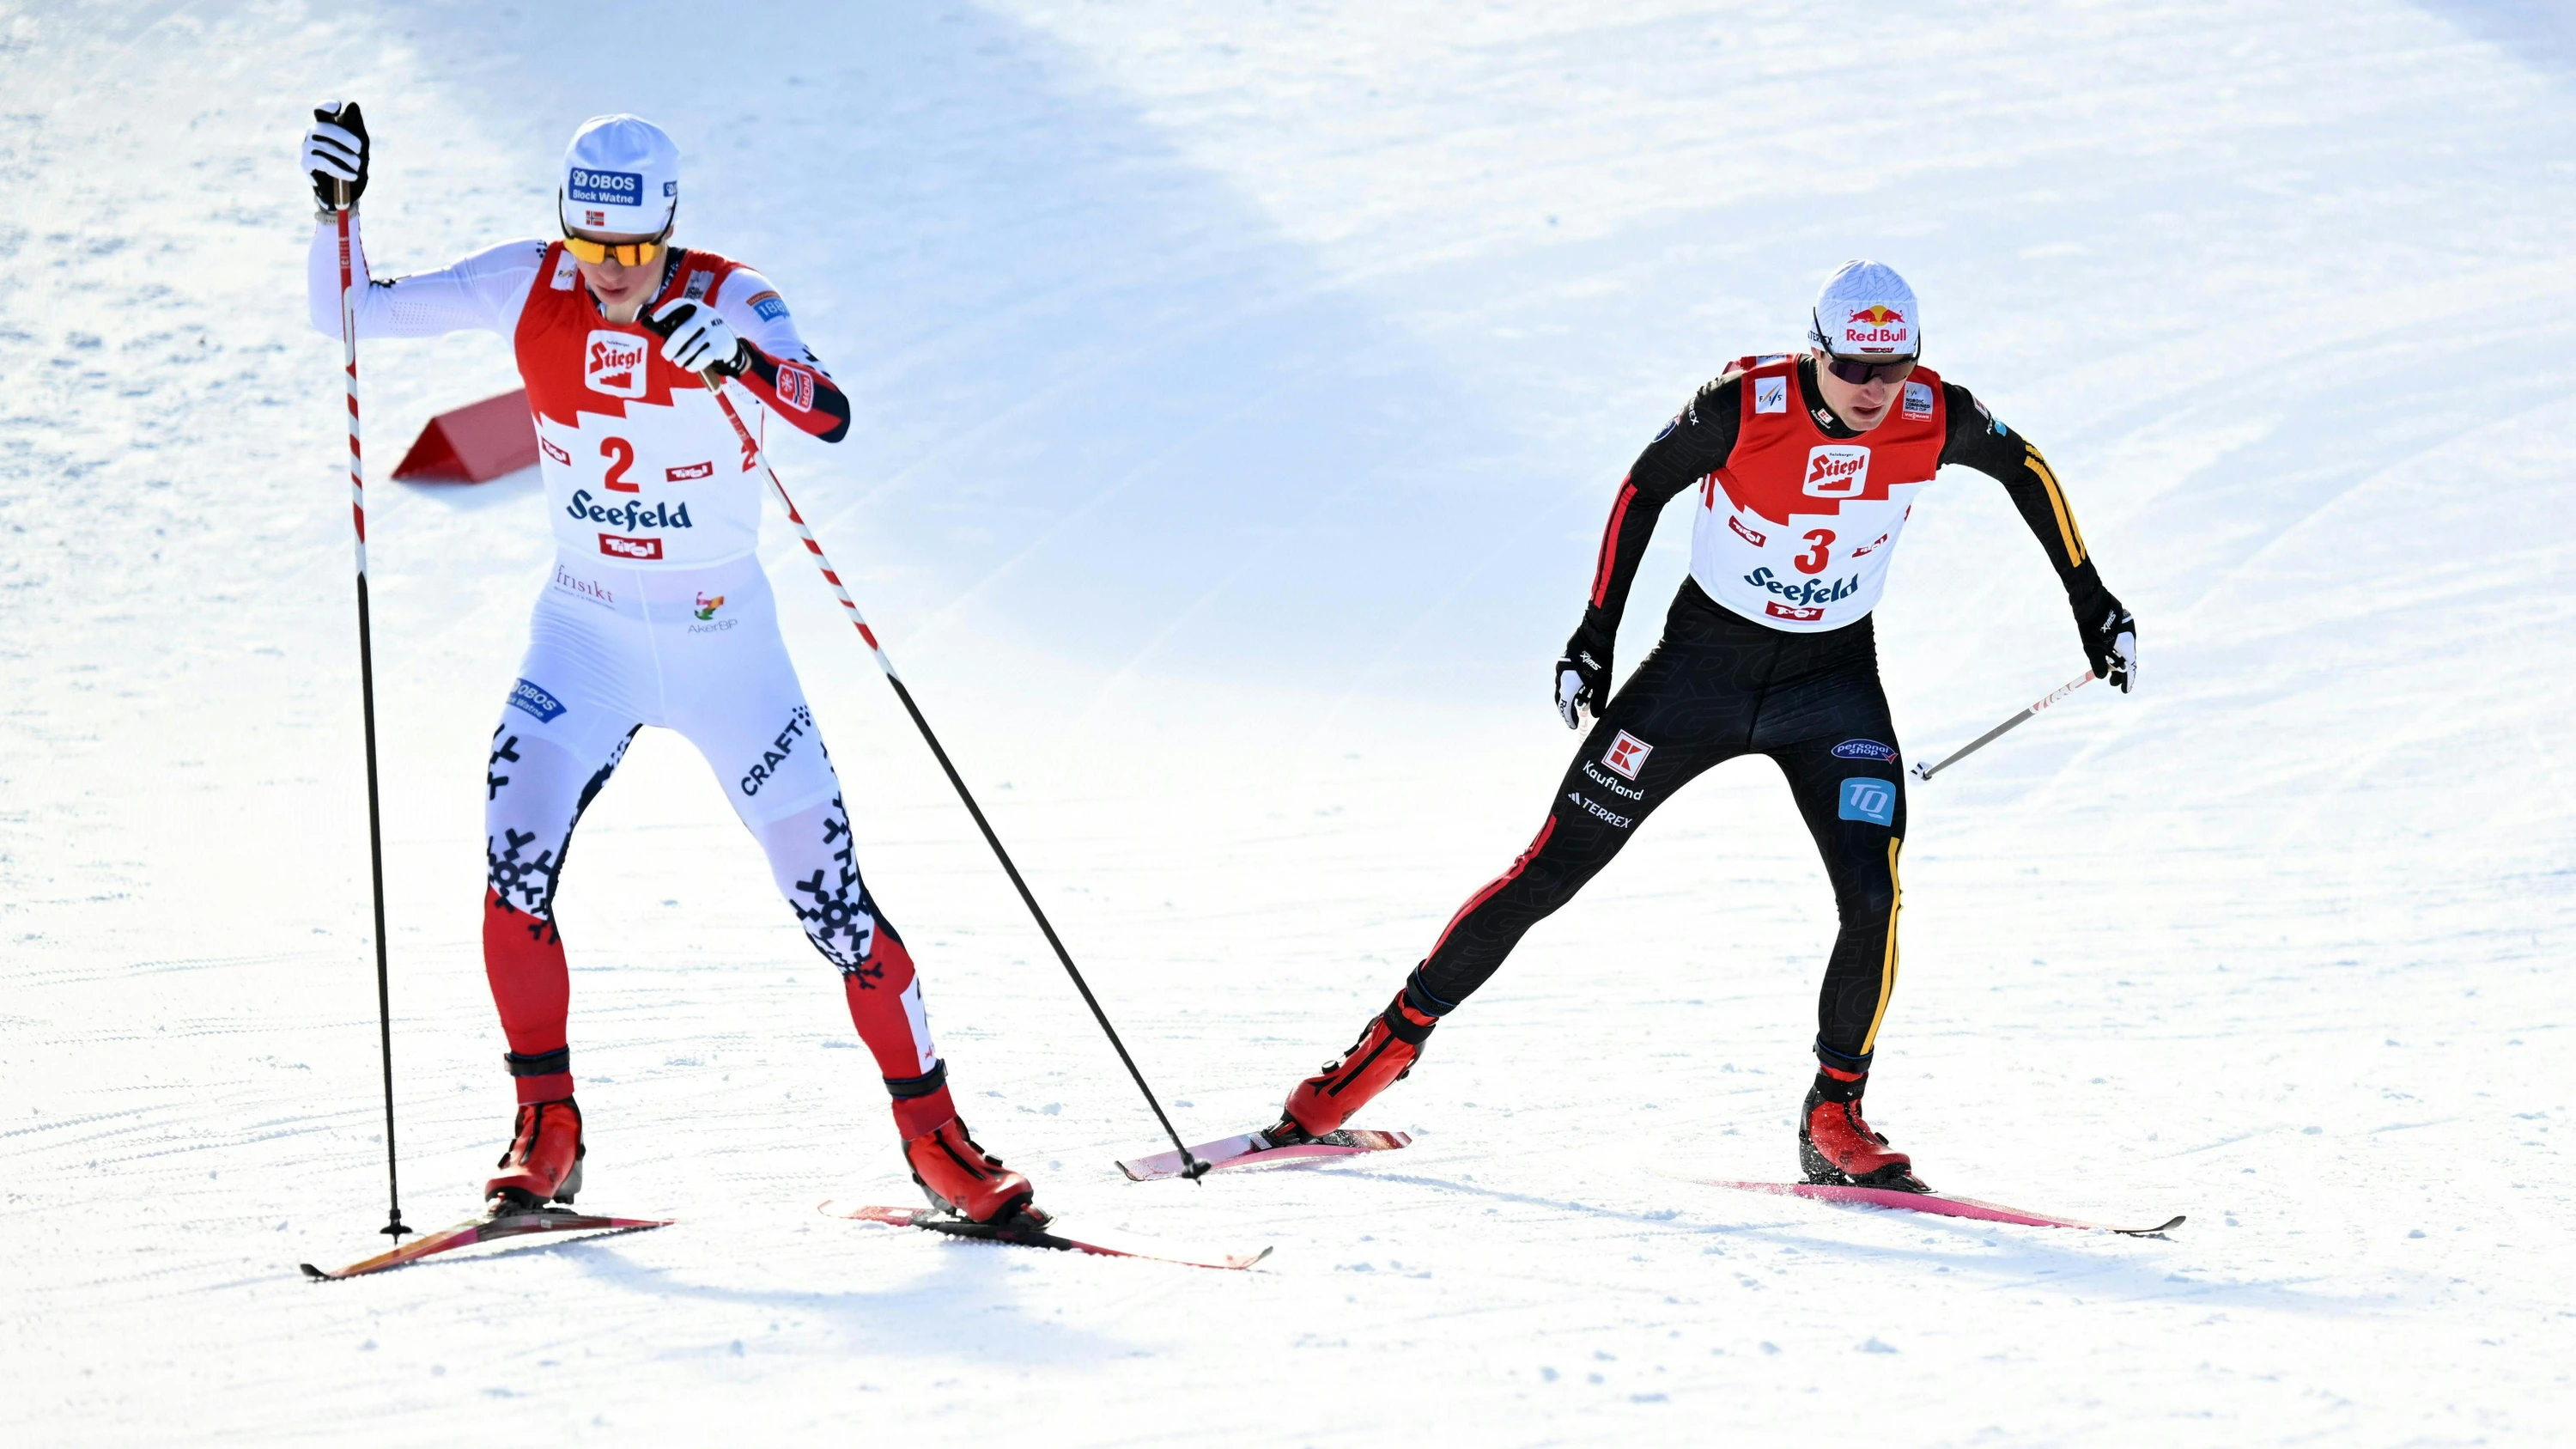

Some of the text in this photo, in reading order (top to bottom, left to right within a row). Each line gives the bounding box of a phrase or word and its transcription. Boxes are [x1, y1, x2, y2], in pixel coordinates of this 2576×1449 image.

[573, 189, 635, 204] Block Watne
[589, 174, 635, 191] OBOS
[1846, 328, 1907, 342] Red Bull
[589, 341, 643, 374] Stiegl
[801, 376, 811, 406] NOR
[1810, 409, 1832, 429] Kaufland
[599, 436, 641, 493] 2
[671, 465, 709, 479] Tirol
[1808, 454, 1866, 484] Stiegl
[566, 489, 693, 533] Seefeld
[605, 538, 656, 557] Tirol
[1794, 528, 1837, 575] 3
[1743, 566, 1859, 606] Seefeld
[517, 684, 557, 711] OBOS
[740, 717, 804, 797] CRAFT
[1837, 743, 1889, 754] personal
[1848, 746, 1879, 756] shop
[1582, 759, 1644, 801] Kaufland
[1582, 797, 1633, 829] TERREX
[1850, 783, 1888, 820] TQ
